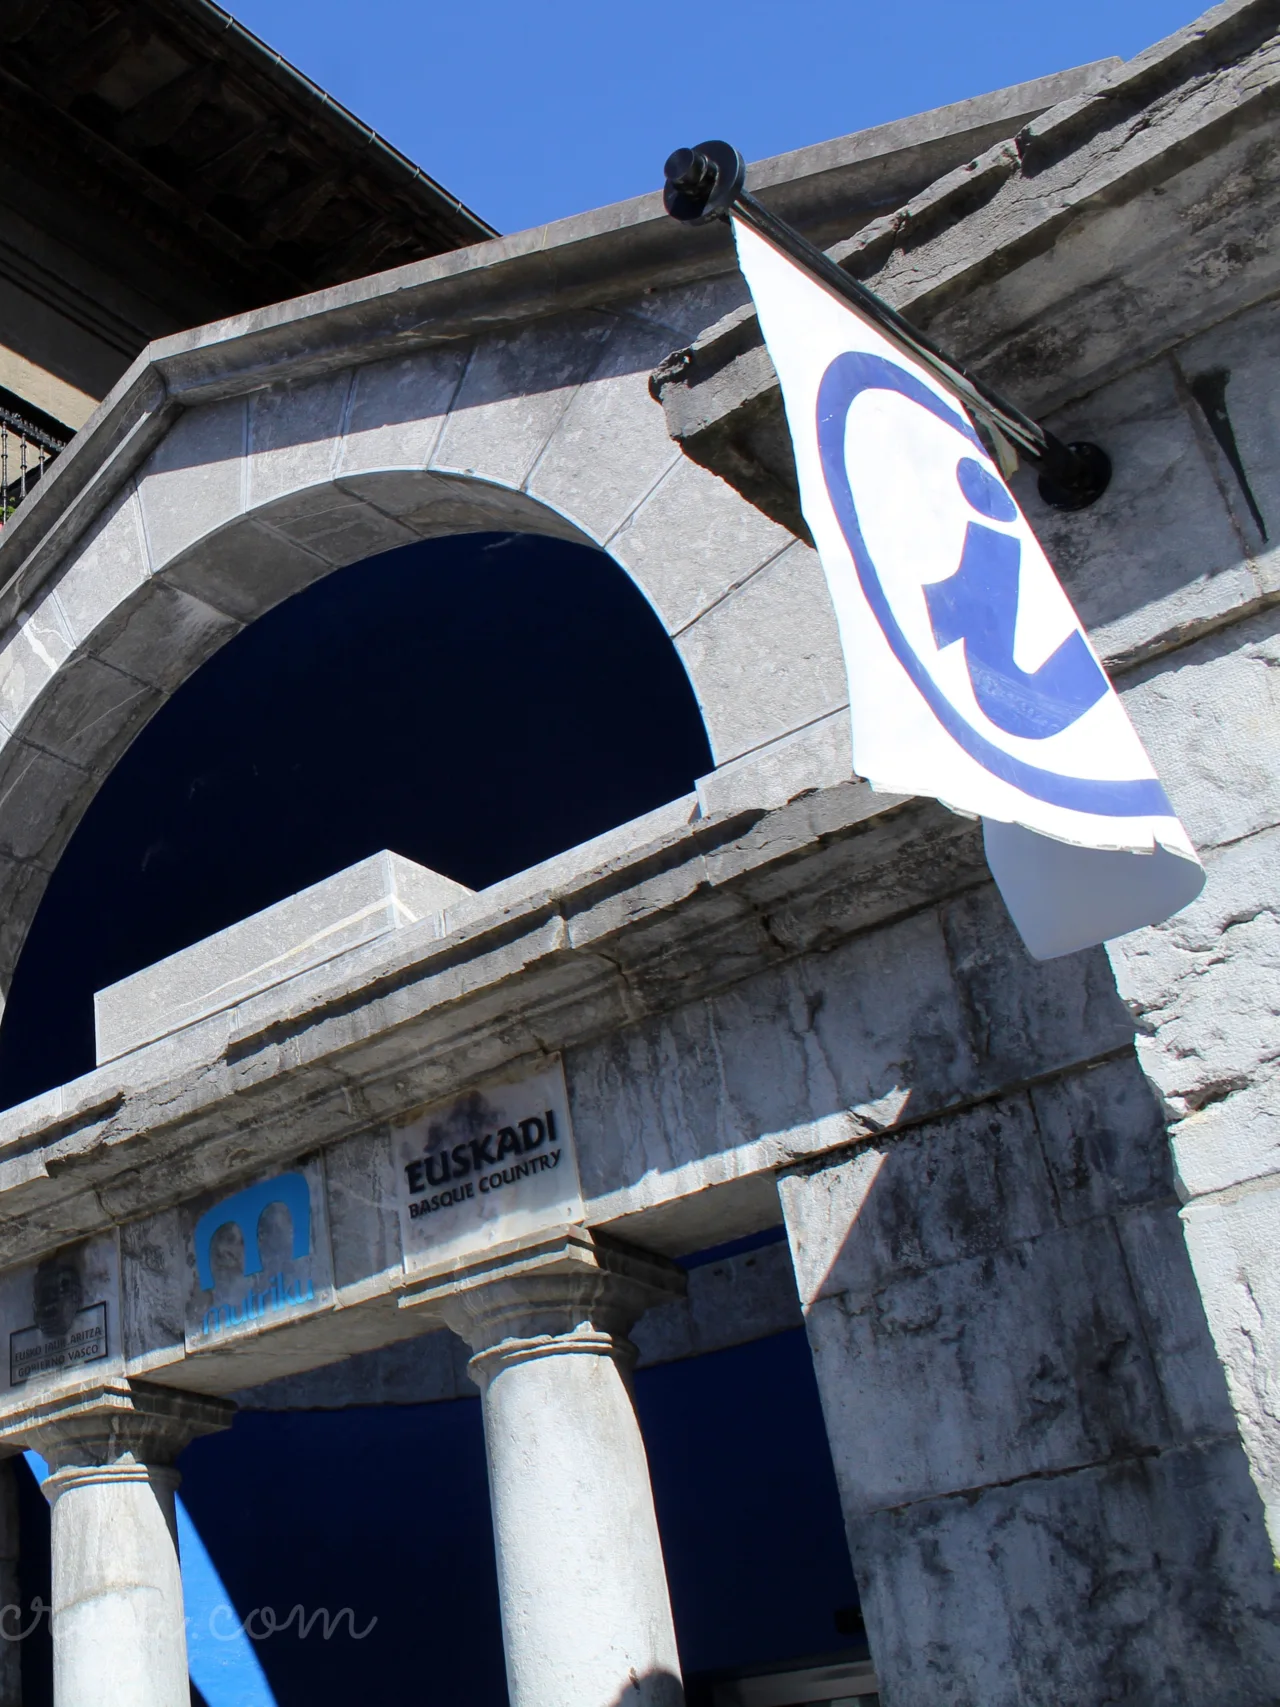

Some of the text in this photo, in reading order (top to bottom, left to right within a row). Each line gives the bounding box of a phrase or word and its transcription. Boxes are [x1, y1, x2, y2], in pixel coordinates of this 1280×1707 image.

[404, 1110, 557, 1195] EUSKADI
[408, 1149, 561, 1219] BASQUE COUNTRY
[203, 1271, 315, 1335] mutriku
[15, 1346, 42, 1362] EUSKO
[67, 1344, 99, 1361] VASCO
